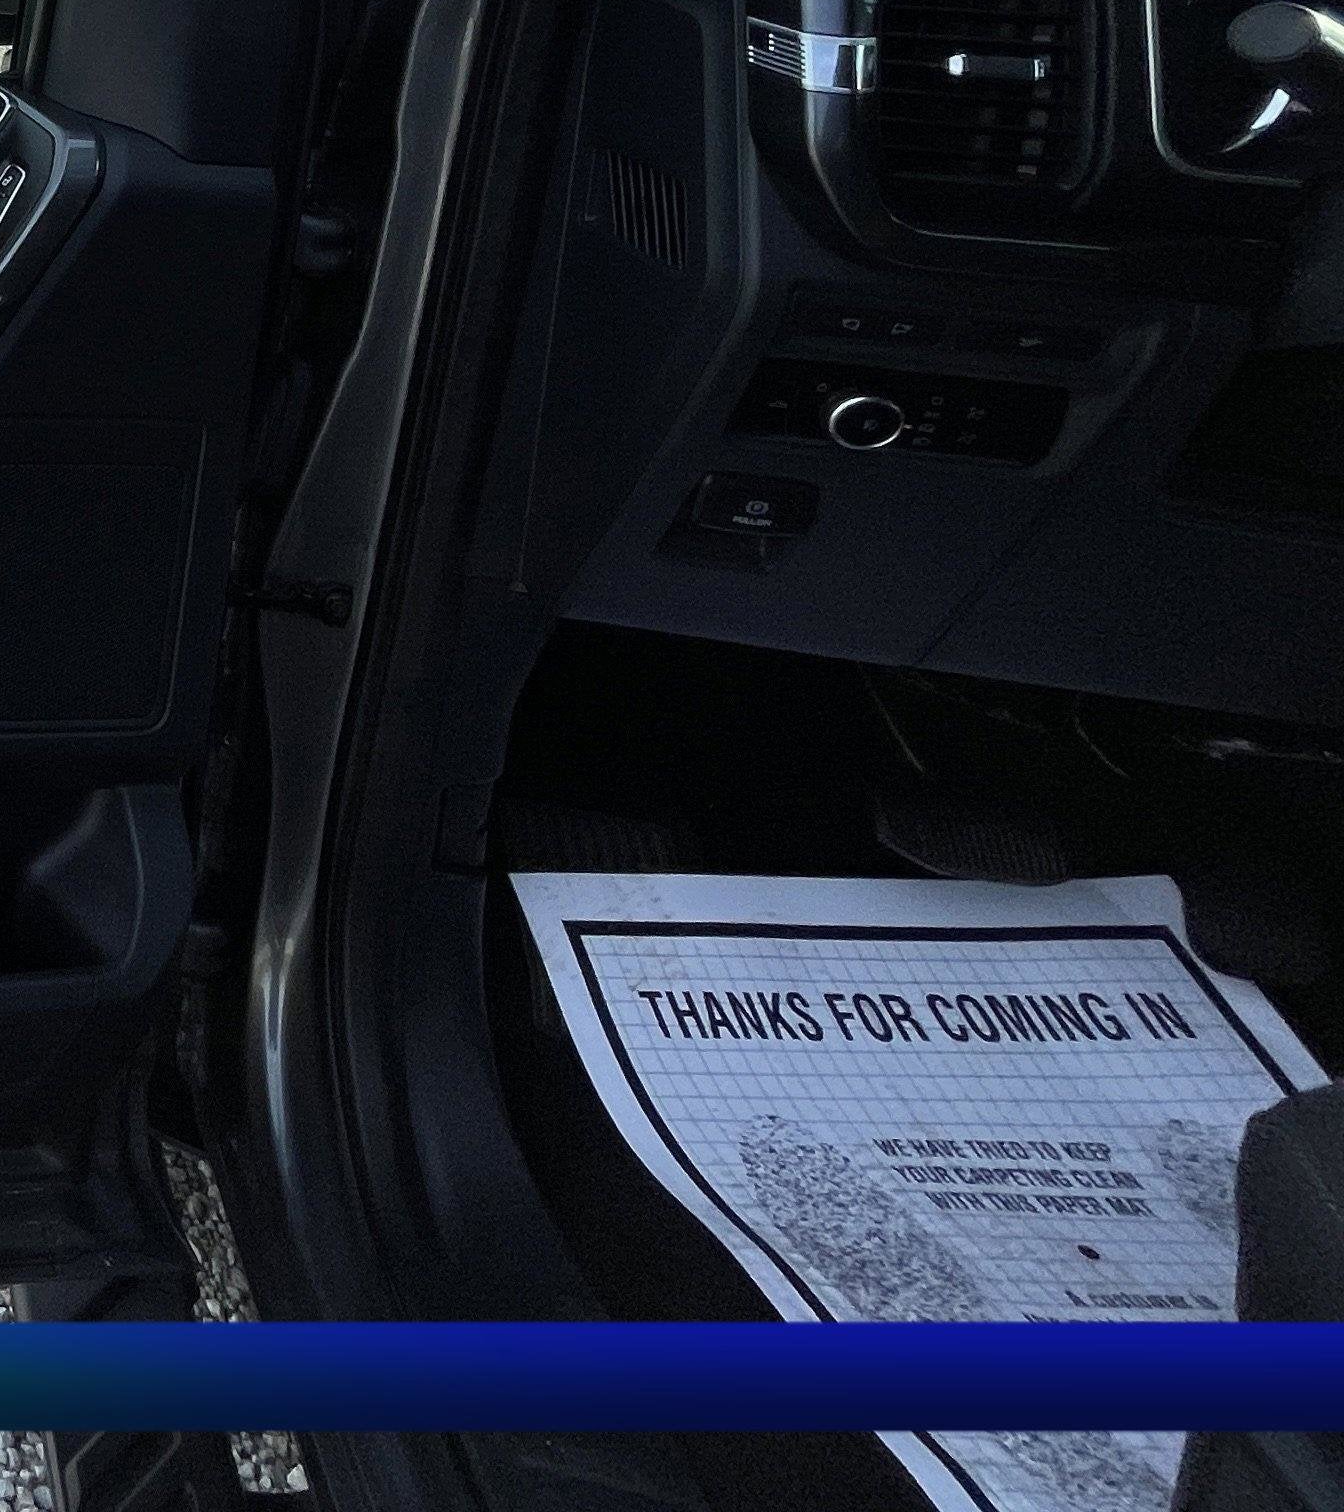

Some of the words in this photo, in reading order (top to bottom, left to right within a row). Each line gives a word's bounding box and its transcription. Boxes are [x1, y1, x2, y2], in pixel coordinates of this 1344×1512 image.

[638, 990, 825, 1041] THANKS
[823, 992, 933, 1043] FOR
[925, 992, 1132, 1043] COMING
[1124, 992, 1198, 1040] IN
[872, 1138, 912, 1157] WE
[907, 1139, 968, 1159] HAVE
[964, 1140, 1031, 1161] TRIED
[1027, 1141, 1062, 1161] TO
[1059, 1142, 1112, 1163] KEEP
[891, 1165, 957, 1184] YOUR
[953, 1167, 1073, 1187] CARPETING
[1069, 1169, 1145, 1190] CLEAN
[924, 1191, 987, 1210] WITH
[981, 1192, 1039, 1214] THIS
[1032, 1194, 1111, 1216] PAPER
[1104, 1196, 1157, 1217] MAT
